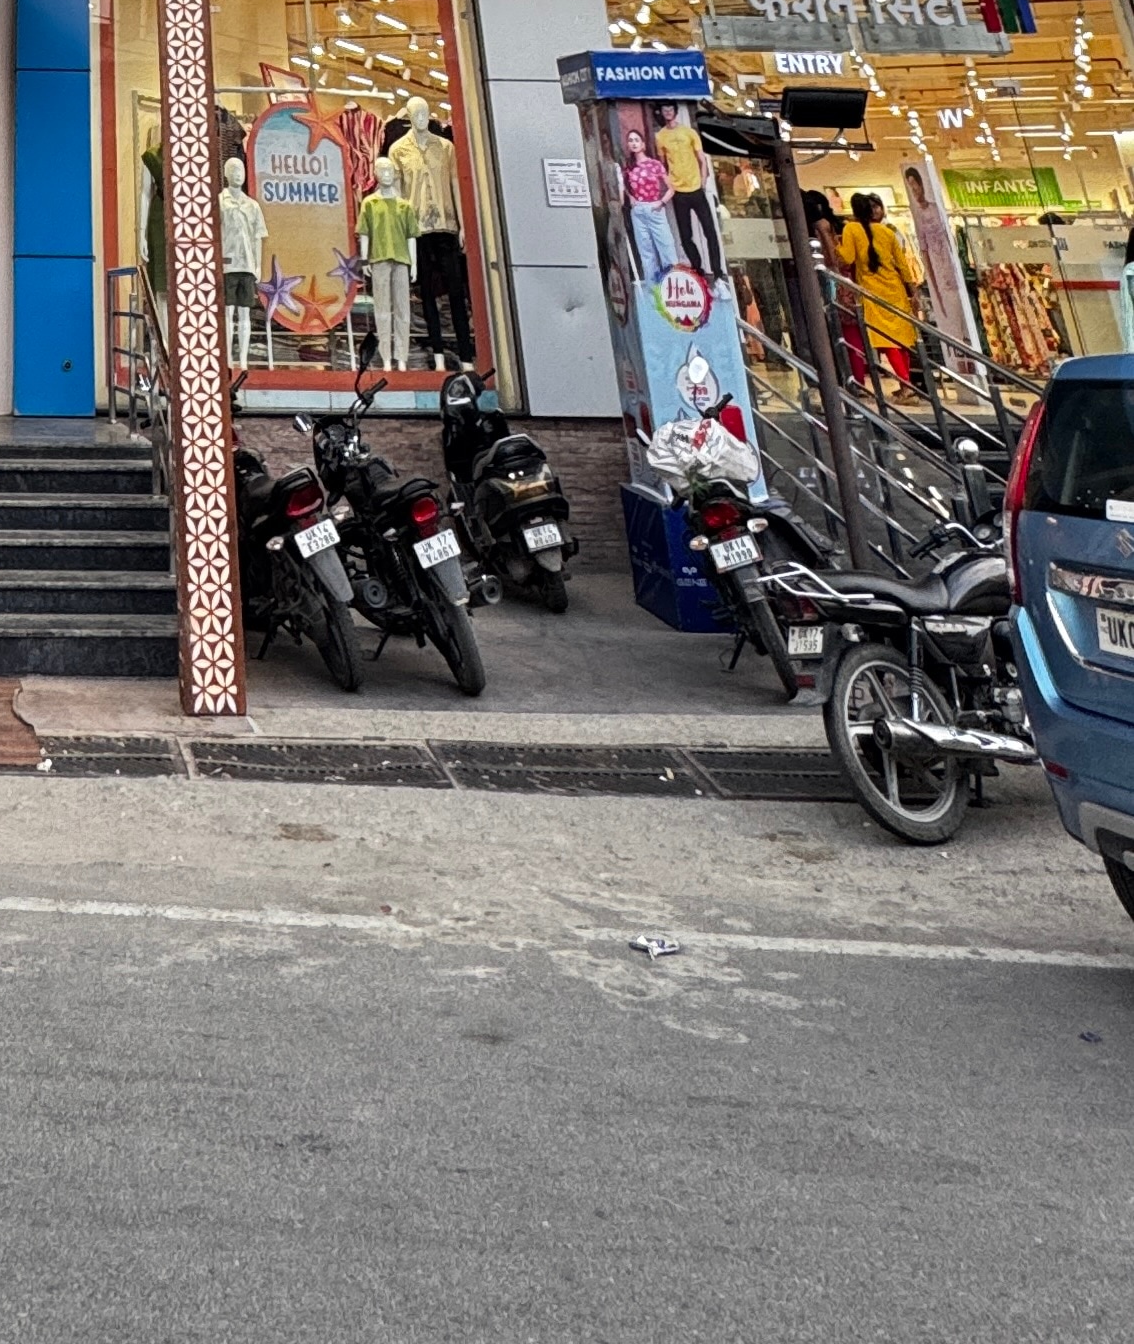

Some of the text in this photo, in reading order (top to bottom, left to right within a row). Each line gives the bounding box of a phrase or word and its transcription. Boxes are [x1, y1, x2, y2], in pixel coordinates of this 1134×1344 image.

[596, 66, 705, 81] FASHION CITY
[774, 53, 844, 75] ENTRY
[270, 154, 329, 177] HELLO!
[263, 182, 339, 203] SUMMER
[966, 179, 1038, 194] INFANTS
[666, 277, 695, 300] Holi
